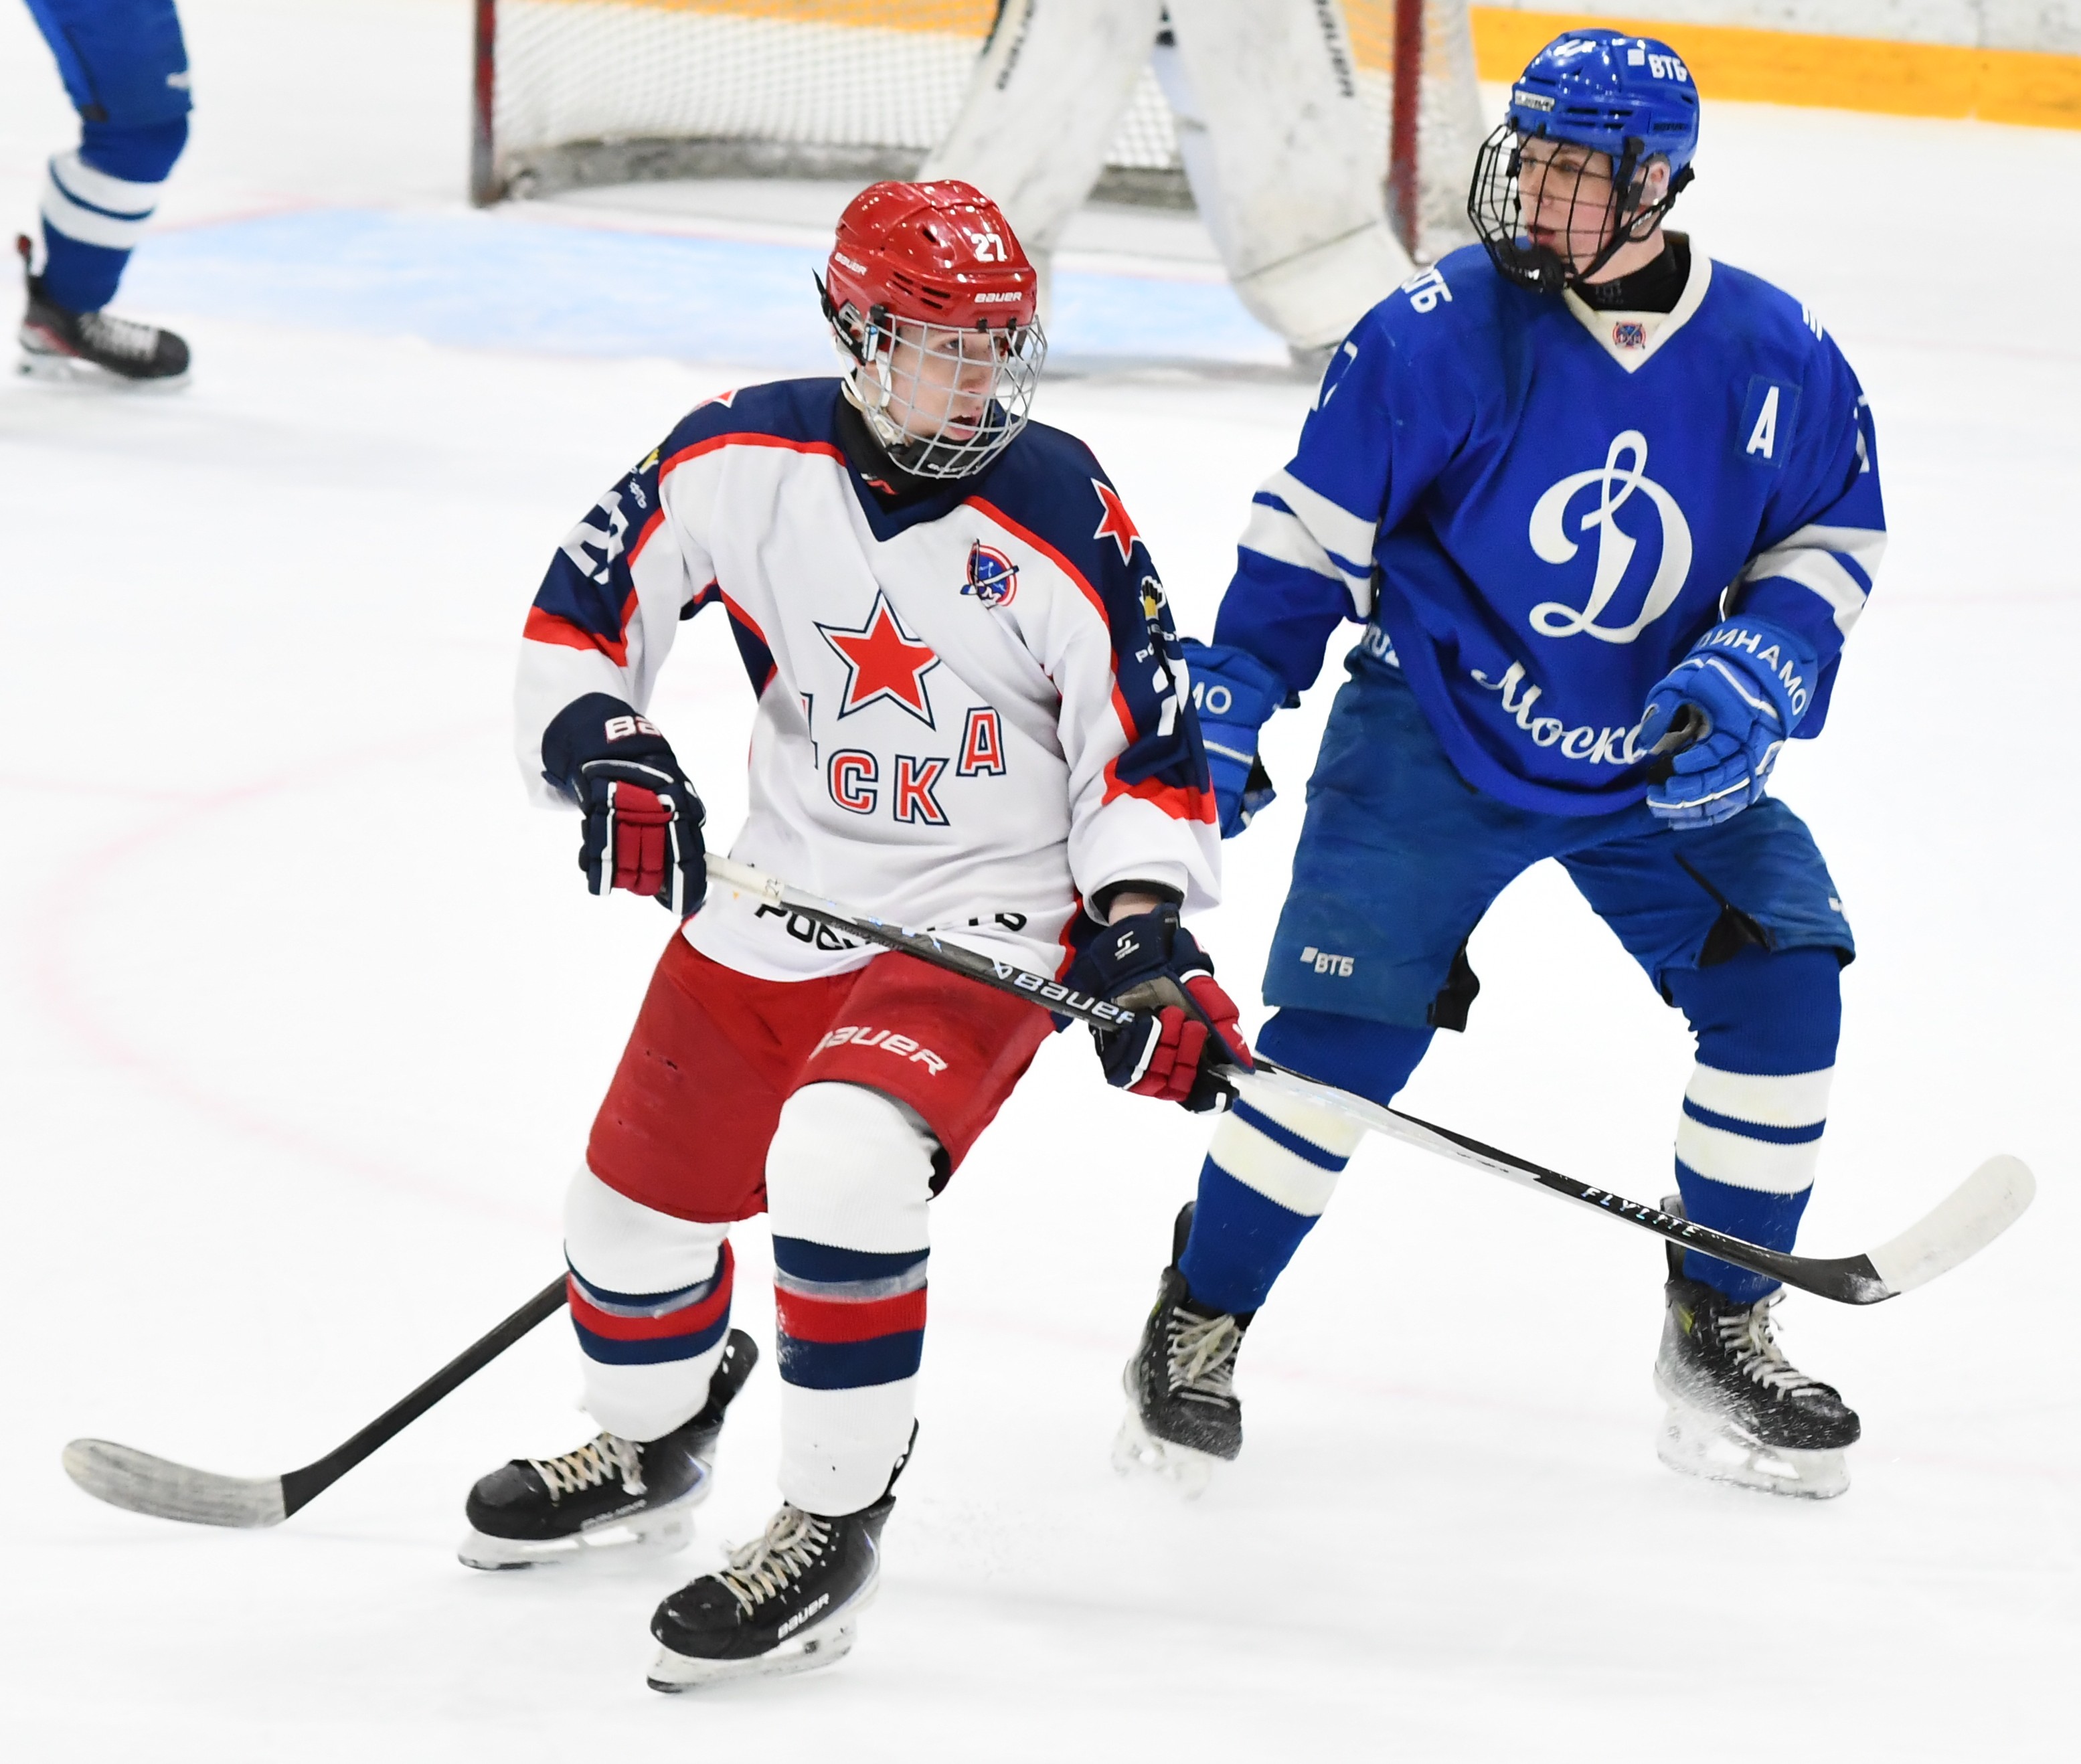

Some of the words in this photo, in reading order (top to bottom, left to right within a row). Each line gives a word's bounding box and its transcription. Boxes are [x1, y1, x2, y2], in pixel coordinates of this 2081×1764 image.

[971, 233, 1008, 262] 27
[975, 291, 1023, 303] BAUER
[1400, 268, 1452, 313] ТБ
[1471, 658, 1649, 765] Моск
[800, 691, 1007, 826] СКА
[777, 1593, 829, 1640] BAUER
